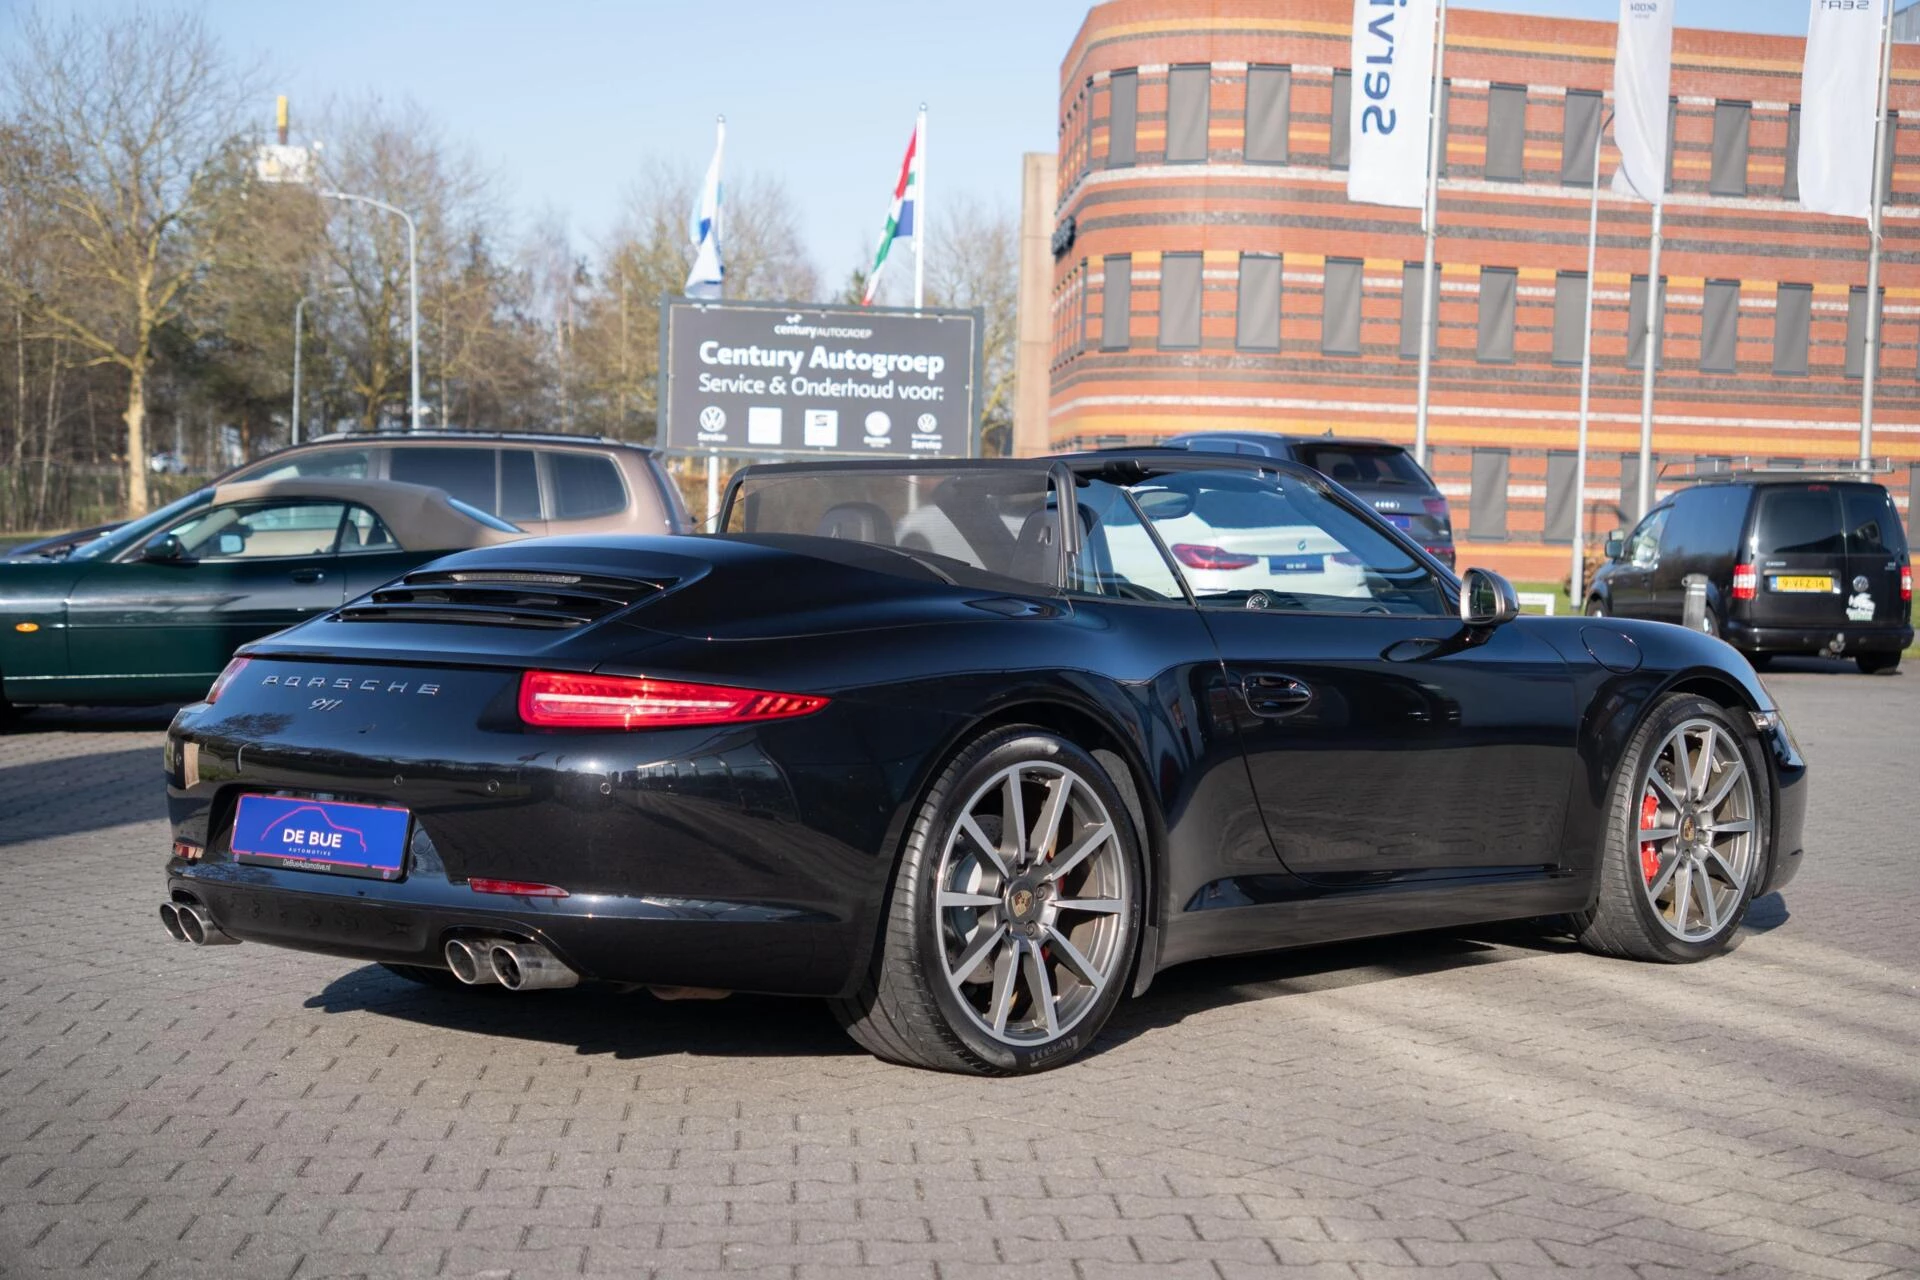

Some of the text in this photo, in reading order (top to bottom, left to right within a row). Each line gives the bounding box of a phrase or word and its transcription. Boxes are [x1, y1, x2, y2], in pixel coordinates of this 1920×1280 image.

[699, 341, 944, 380] Century Autogroep
[699, 373, 944, 400] Service & Onderhoud voor:
[262, 675, 440, 695] PORSCHE
[308, 698, 343, 711] 911
[283, 829, 343, 848] DE BUE
[289, 847, 331, 856] AUTOMOTIVE
